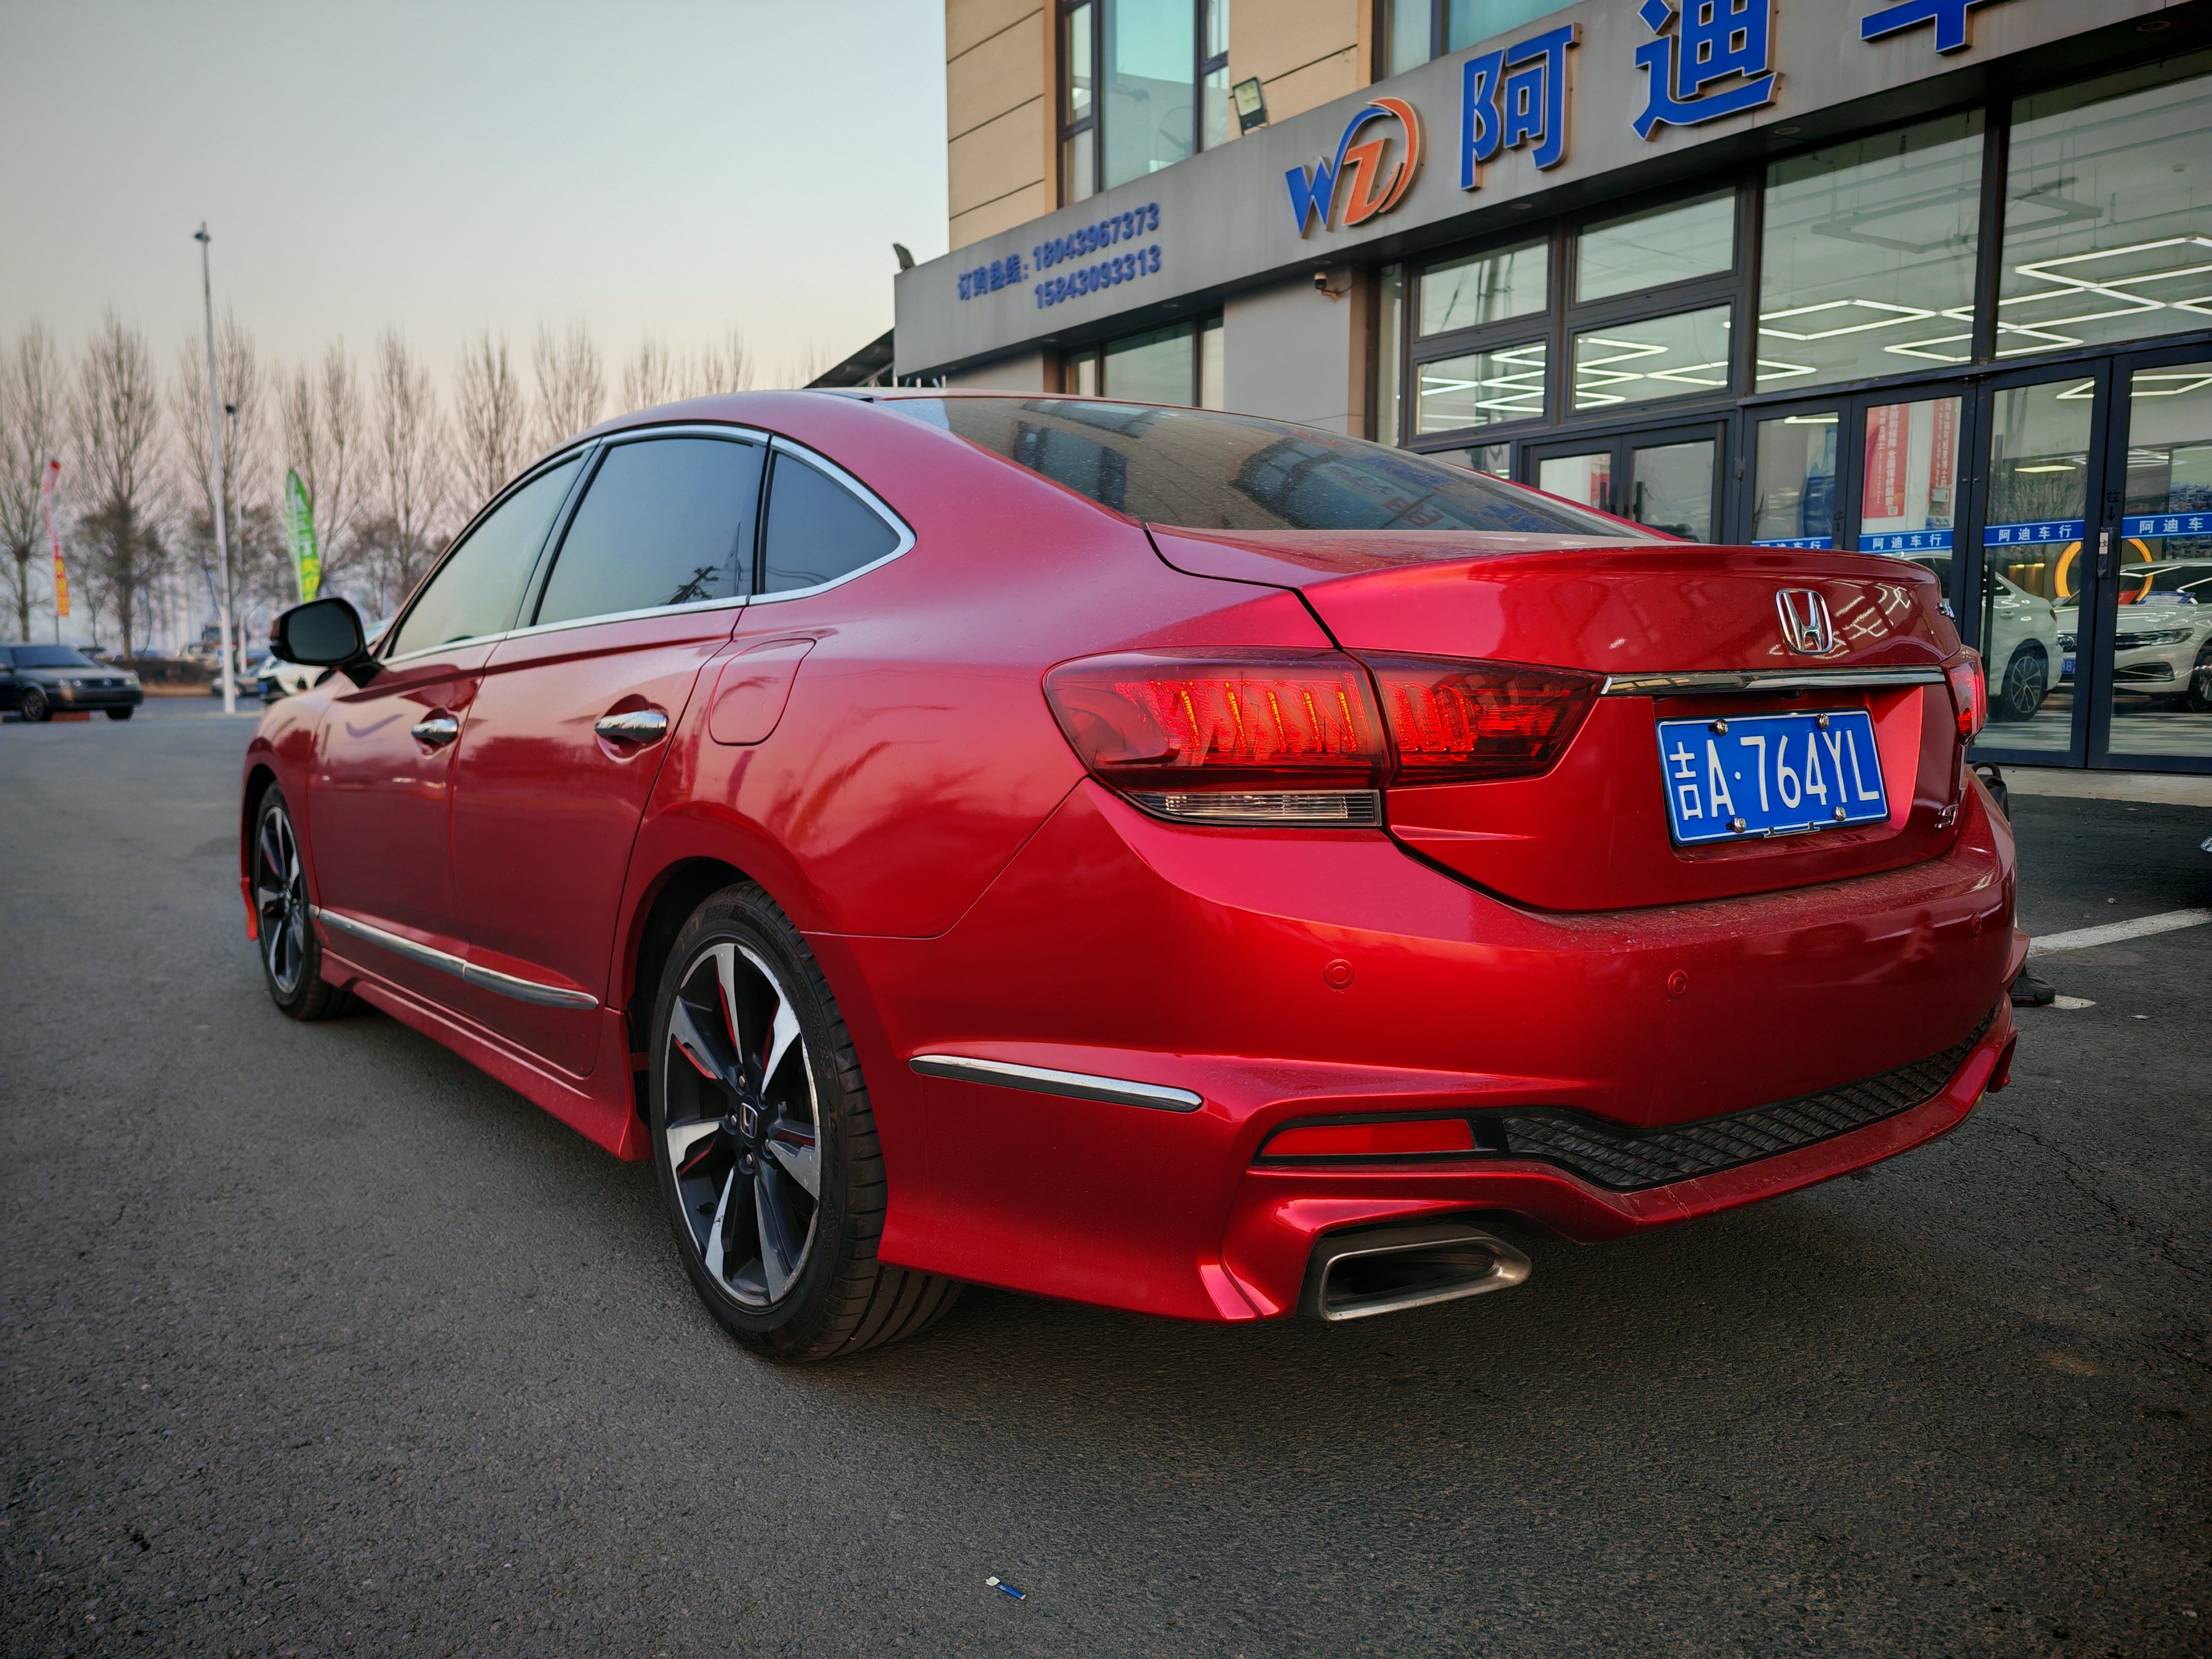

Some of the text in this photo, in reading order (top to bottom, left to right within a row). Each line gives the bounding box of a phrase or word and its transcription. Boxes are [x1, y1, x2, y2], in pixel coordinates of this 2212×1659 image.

[1033, 202, 1159, 271] 18043967373
[1035, 245, 1161, 309] 15843093313
[1872, 534, 1942, 550] 阿迪车行
[1998, 524, 2072, 542] 阿迪车行
[2139, 517, 2203, 534] 阿迪车
[1669, 729, 1880, 820] 吉A·764YL
